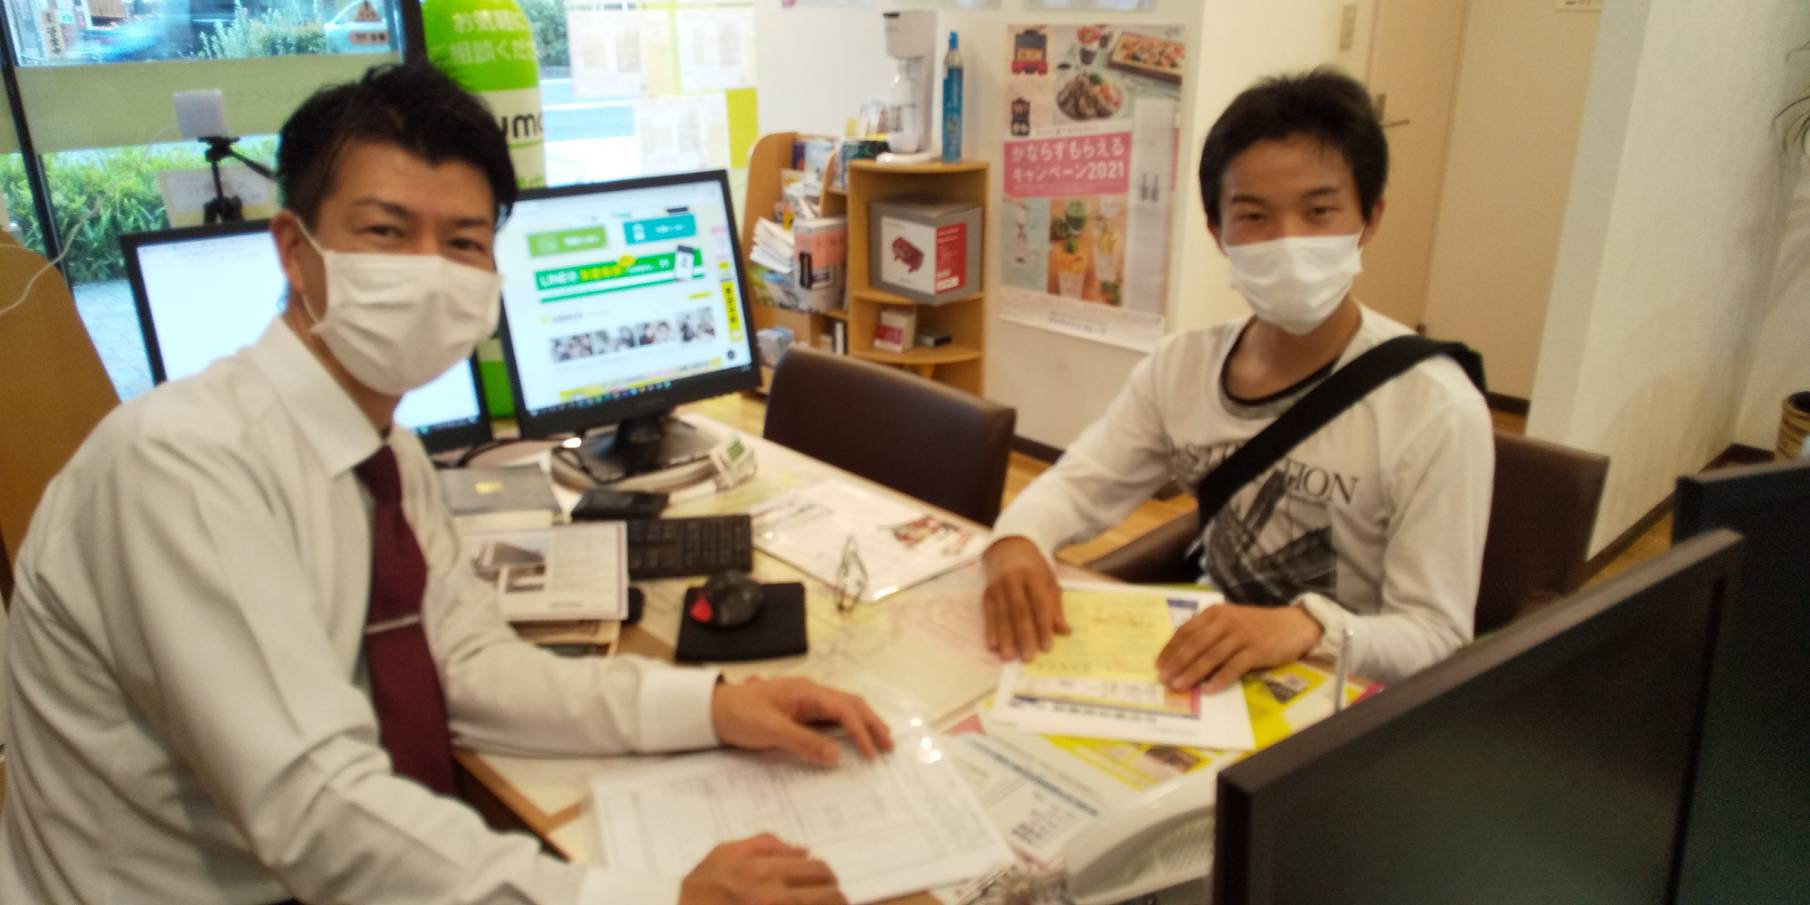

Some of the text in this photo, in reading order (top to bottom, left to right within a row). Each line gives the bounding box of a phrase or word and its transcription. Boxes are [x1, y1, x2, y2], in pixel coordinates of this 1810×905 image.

[1011, 136, 1125, 162] かならずもらえる
[1012, 161, 1125, 184] キャンペーン2021
